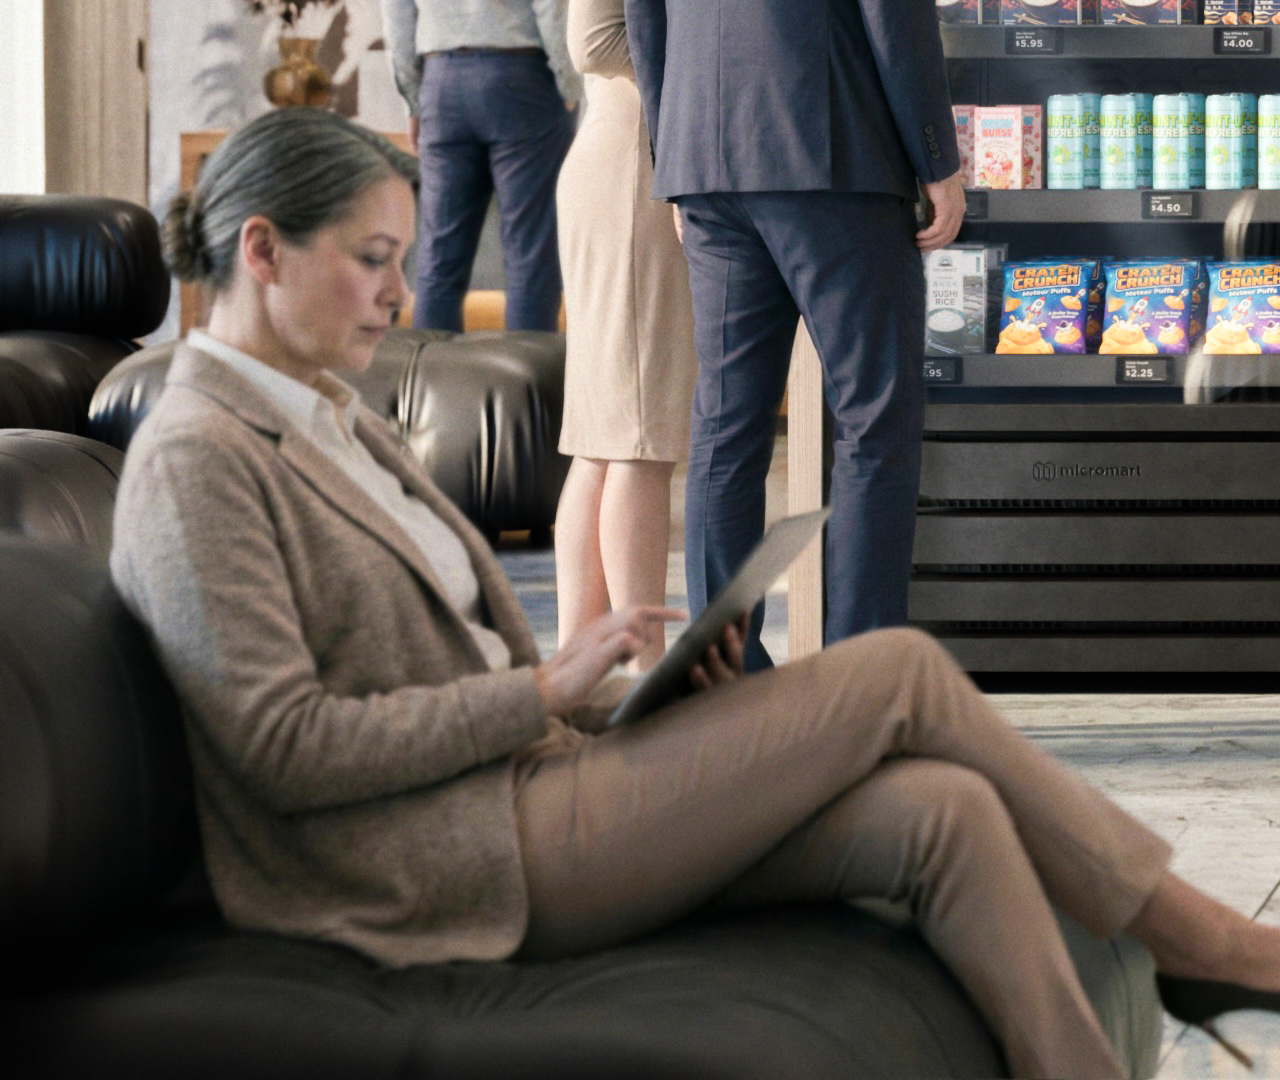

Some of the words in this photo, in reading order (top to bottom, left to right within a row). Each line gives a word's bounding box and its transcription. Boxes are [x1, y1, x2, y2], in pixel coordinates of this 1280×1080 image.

[1015, 40, 1043, 48] $5.95
[1224, 40, 1253, 48] $4.00
[1151, 204, 1181, 212] $4.50
[1014, 266, 1079, 279] CRATER
[1117, 266, 1183, 279] CRATER
[1013, 276, 1079, 289] CRUNCH
[1116, 276, 1181, 289] CRUNCH
[1022, 289, 1049, 297] Meteor
[1126, 289, 1152, 297] Meteor
[1229, 289, 1256, 297] Meteor
[1126, 369, 1153, 378] $2.25
[1060, 463, 1141, 477] micromart
